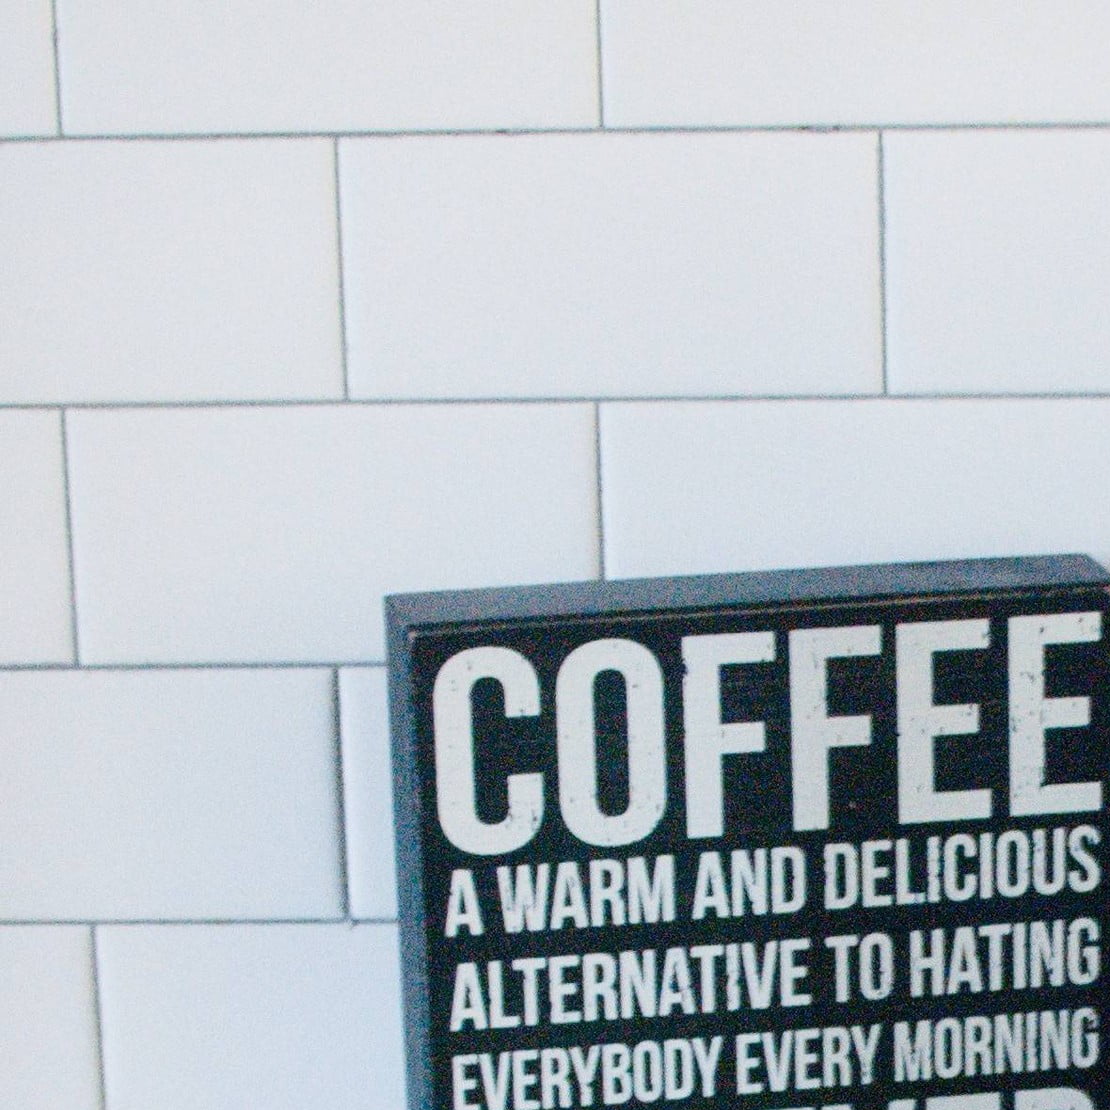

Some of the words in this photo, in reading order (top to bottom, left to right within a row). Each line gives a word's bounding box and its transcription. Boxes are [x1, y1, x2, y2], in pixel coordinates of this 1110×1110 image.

[433, 612, 1101, 855] COFFEE
[446, 869, 483, 937] A
[497, 855, 675, 933] WARM
[693, 847, 805, 919] AND
[824, 826, 1100, 909] DELICIOUS
[450, 939, 811, 1031] ALTERNATIVE
[825, 933, 894, 1002] TO
[910, 918, 1099, 996] HATING
[736, 1025, 880, 1094] EVERY
[894, 1008, 1098, 1081] MORNING
